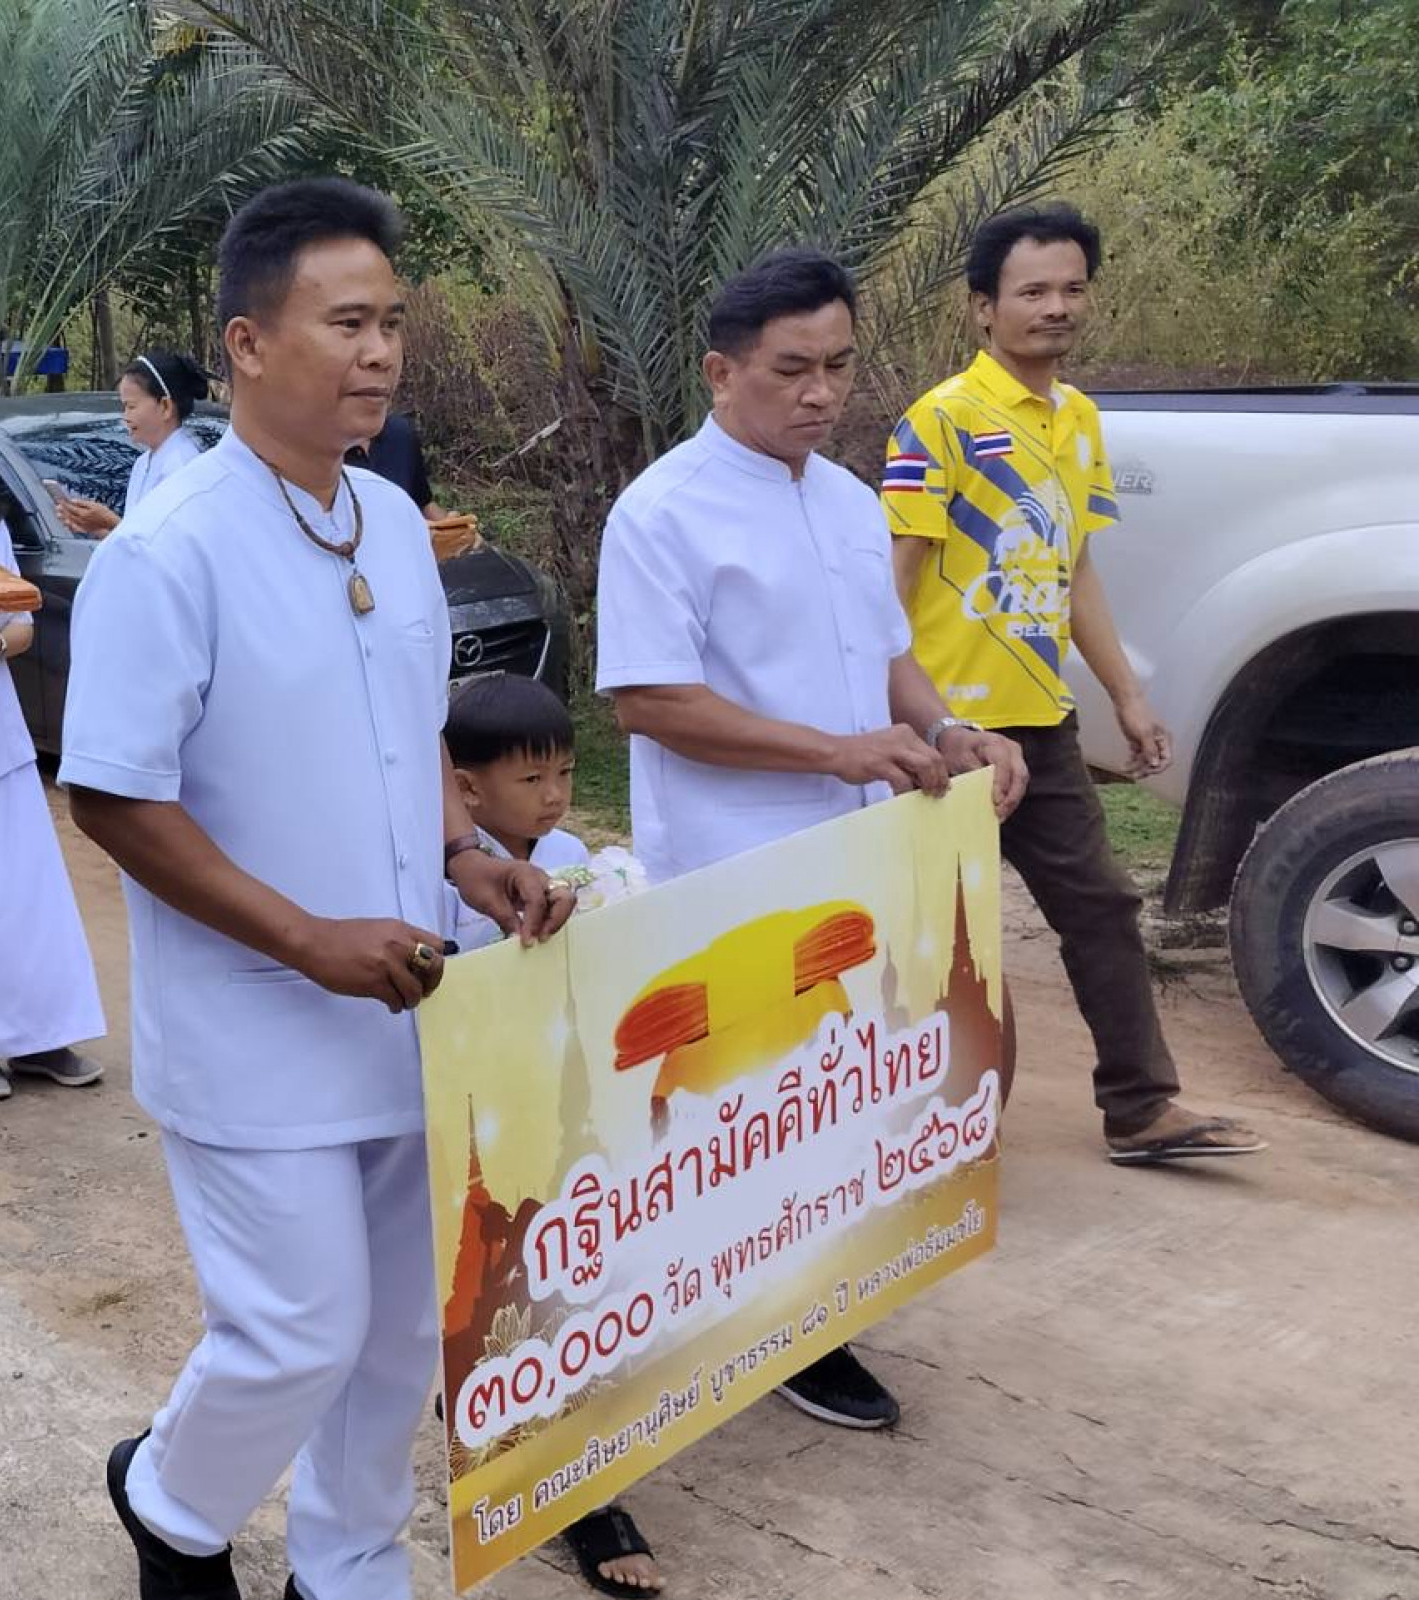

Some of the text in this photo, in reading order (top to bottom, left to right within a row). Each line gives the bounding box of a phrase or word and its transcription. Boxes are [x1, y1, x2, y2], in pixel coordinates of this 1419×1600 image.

[468, 1085, 991, 1430] ๓๐,๐๐๐ วัด พุทธศักราช ๒๕๖๘
[535, 1020, 942, 1286] กฐินสามัคคีทั่วไทย
[474, 1498, 522, 1541] โดย
[534, 1366, 702, 1509] คณะศิษยานุศิษย์
[710, 1325, 793, 1401] บูชาธรรม
[801, 1303, 828, 1336] ๘๑
[834, 1281, 849, 1313] ปี
